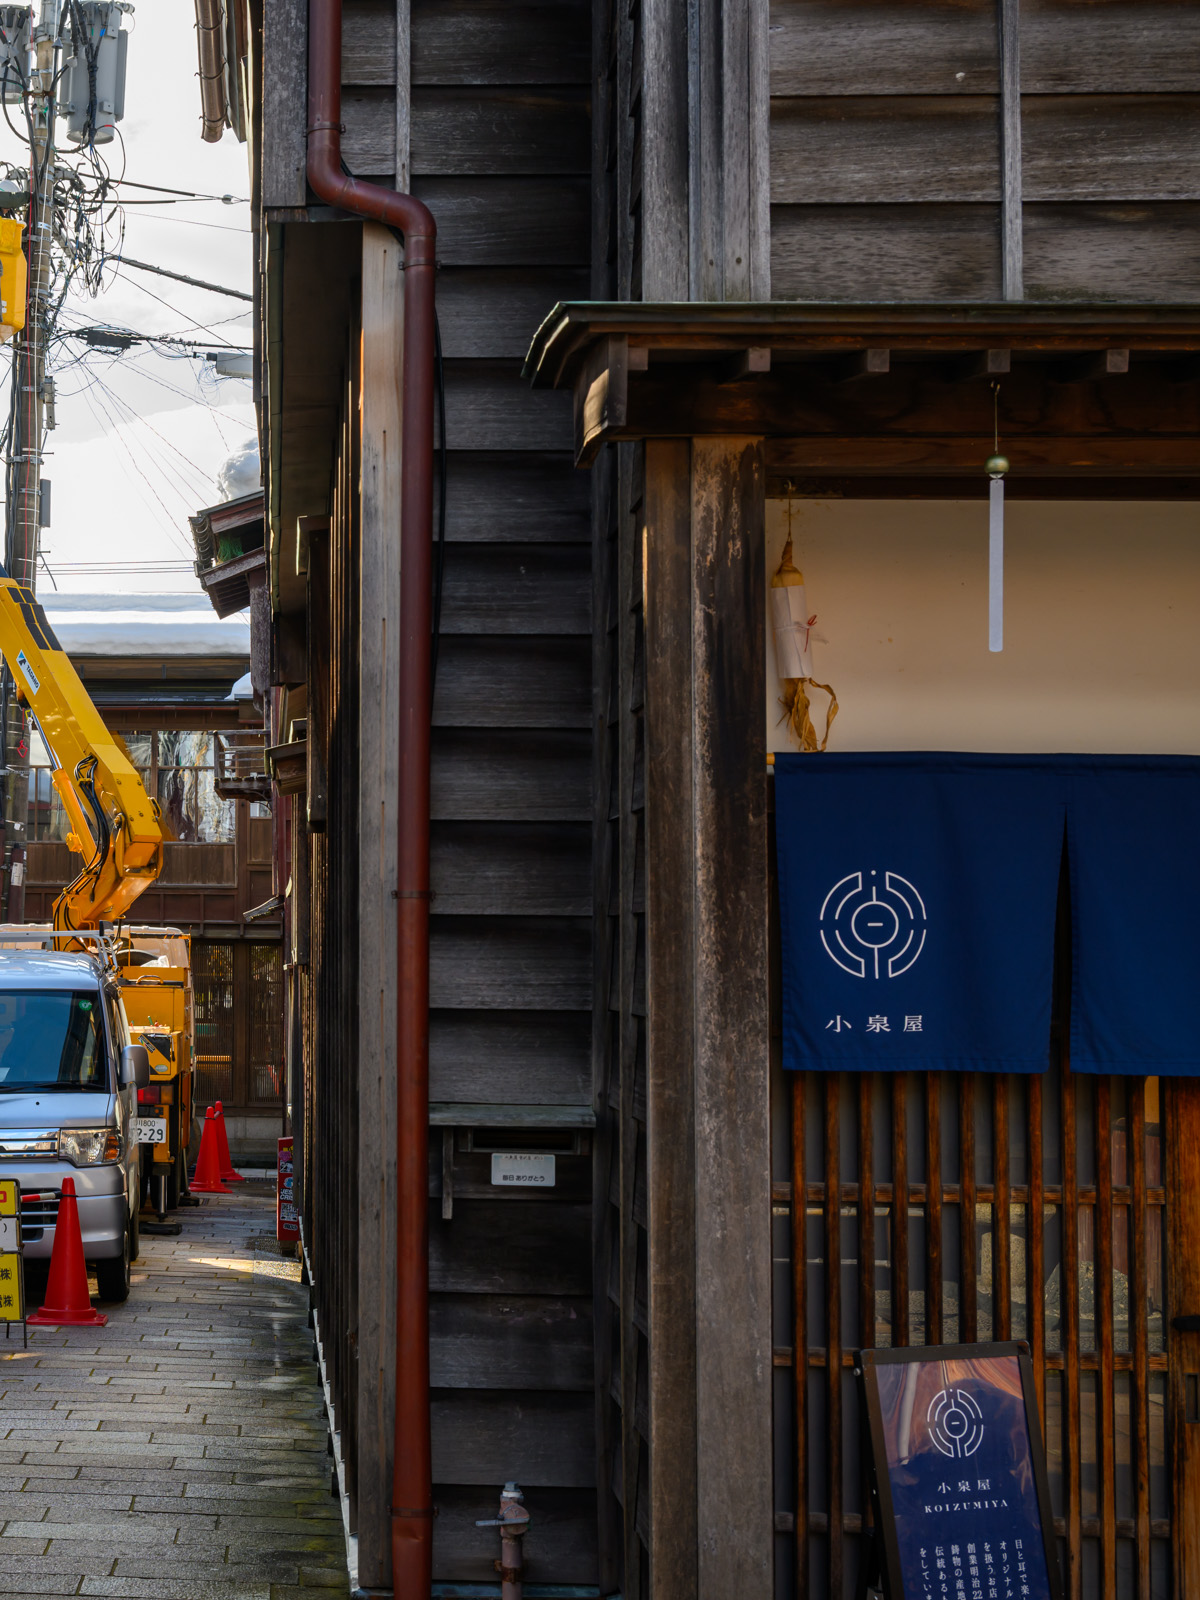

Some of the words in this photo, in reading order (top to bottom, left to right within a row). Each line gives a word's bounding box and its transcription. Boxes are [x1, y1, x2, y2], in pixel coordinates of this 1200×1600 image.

[26, 665, 39, 688] TADANO
[825, 1014, 923, 1033] 小泉屋
[137, 1128, 163, 1141] 2-29
[937, 1479, 991, 1494] 小泉屋
[924, 1499, 1008, 1513] KOIZUMIYA
[967, 1543, 983, 1600] 創業明治22
[983, 1542, 998, 1598] を扱うお店
[999, 1540, 1014, 1598] オリジナル
[1014, 1539, 1030, 1600] 目と耳で楽
